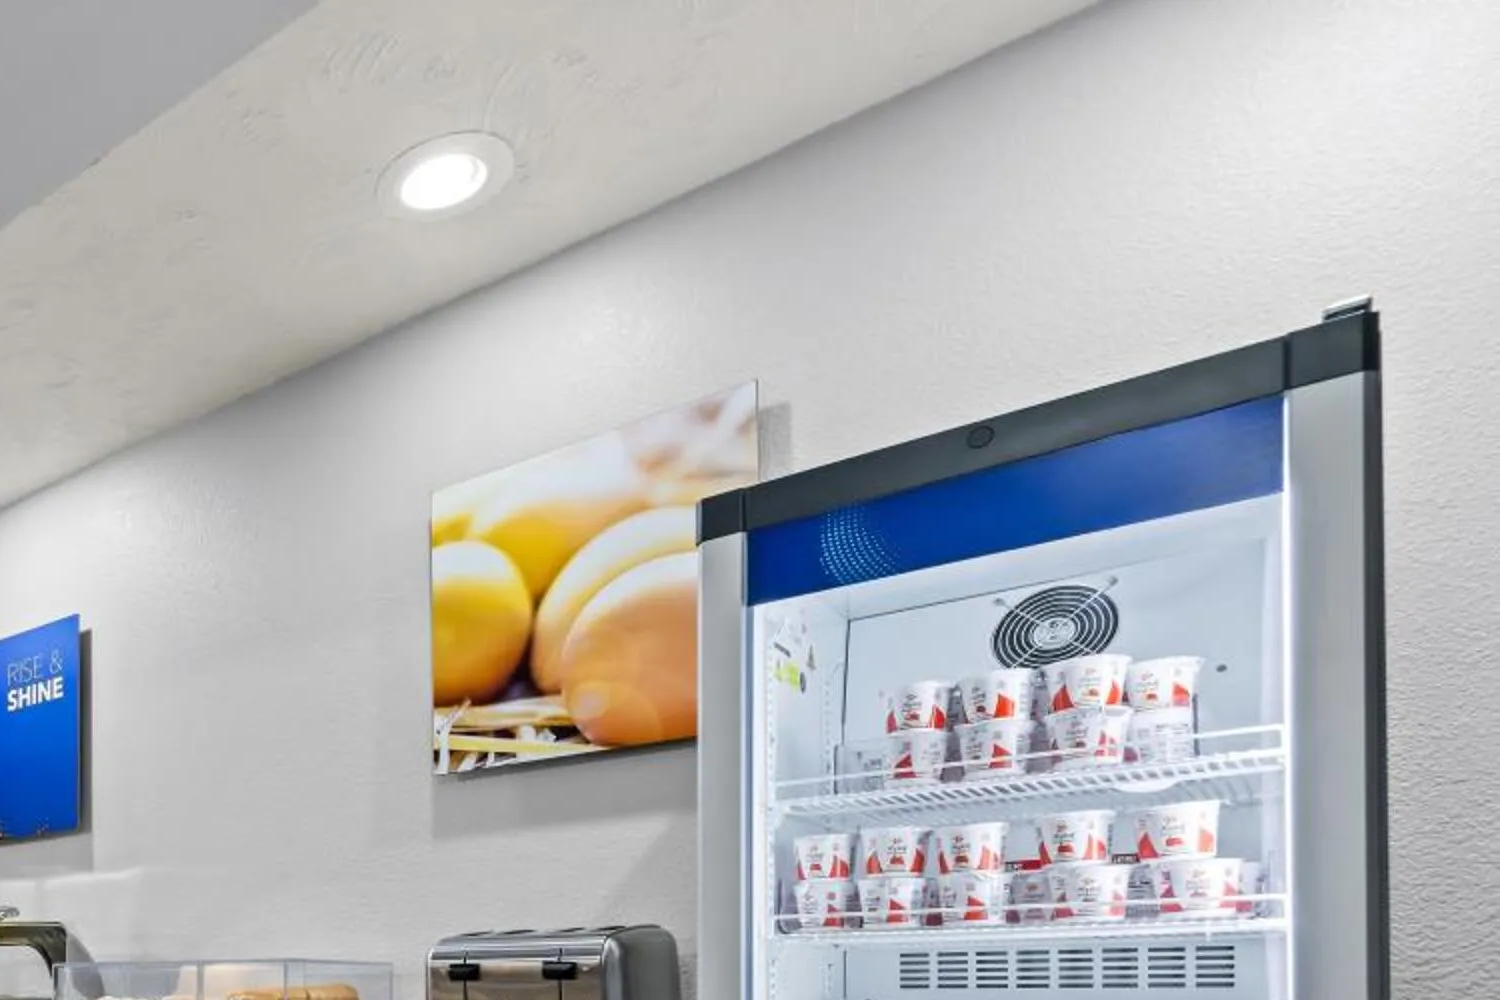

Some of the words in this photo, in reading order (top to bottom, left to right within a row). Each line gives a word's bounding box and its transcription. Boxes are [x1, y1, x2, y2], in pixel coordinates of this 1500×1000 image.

[8, 654, 43, 686] RISE
[50, 649, 63, 674] &
[7, 676, 64, 712] SHINE
